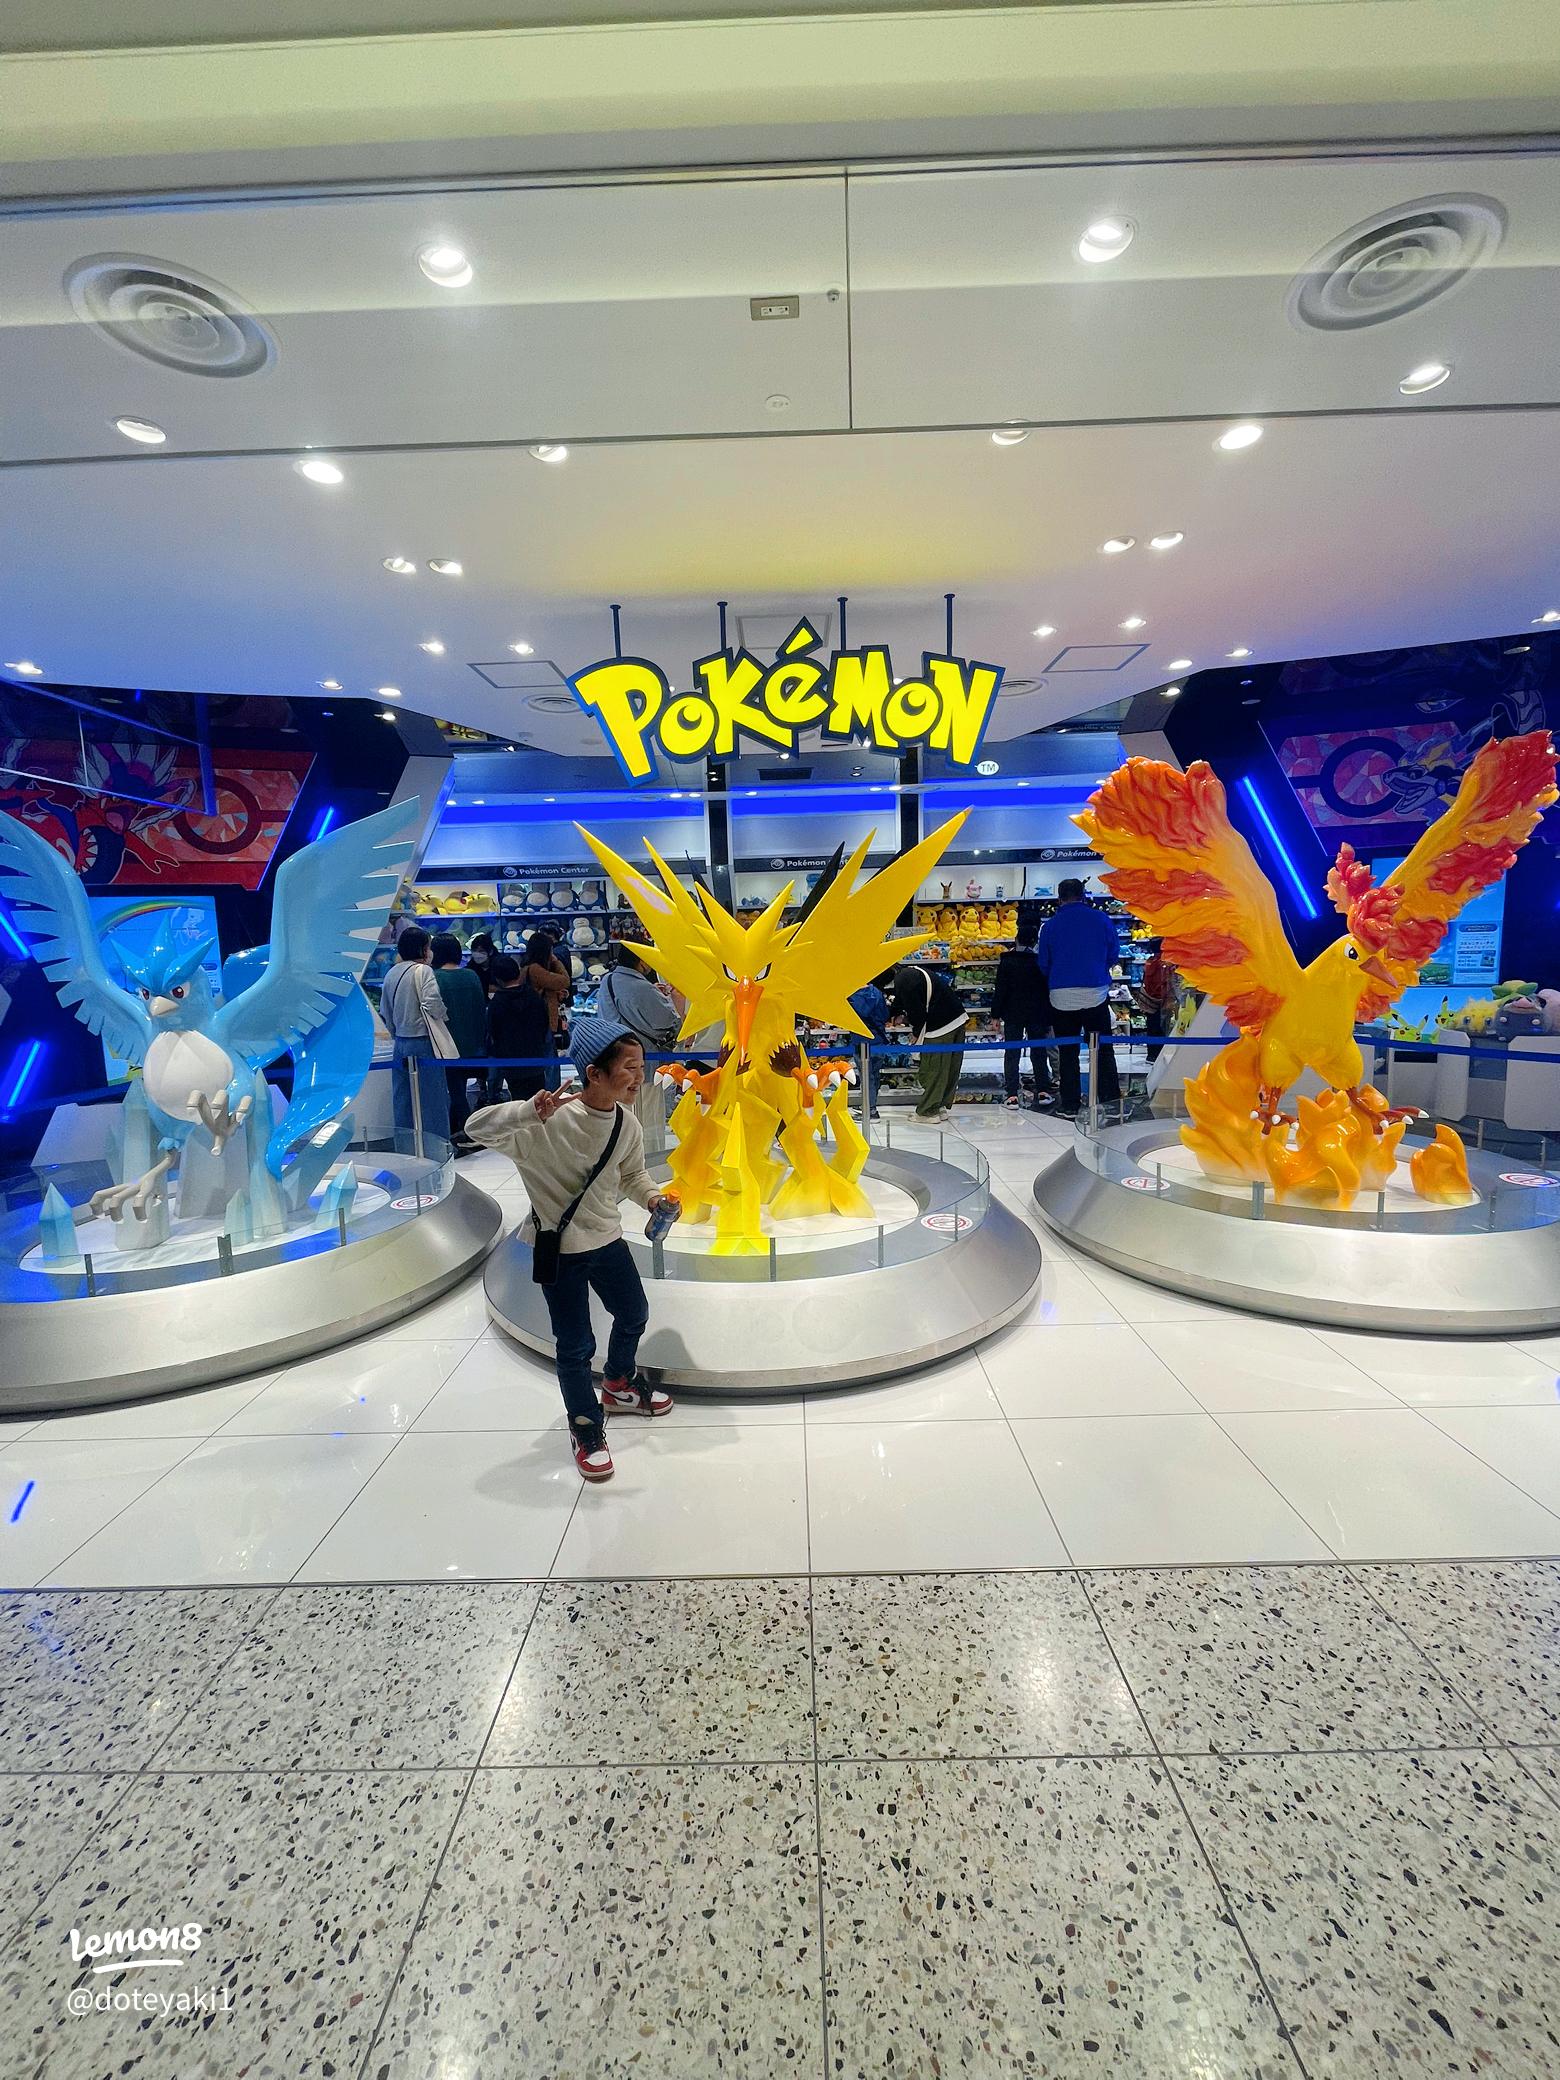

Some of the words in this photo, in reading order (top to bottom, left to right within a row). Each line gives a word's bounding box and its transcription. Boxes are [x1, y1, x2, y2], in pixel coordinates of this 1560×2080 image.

[1057, 849, 1097, 858] Pokémon
[787, 859, 826, 867] Pokémon
[519, 867, 559, 875] Pokémon
